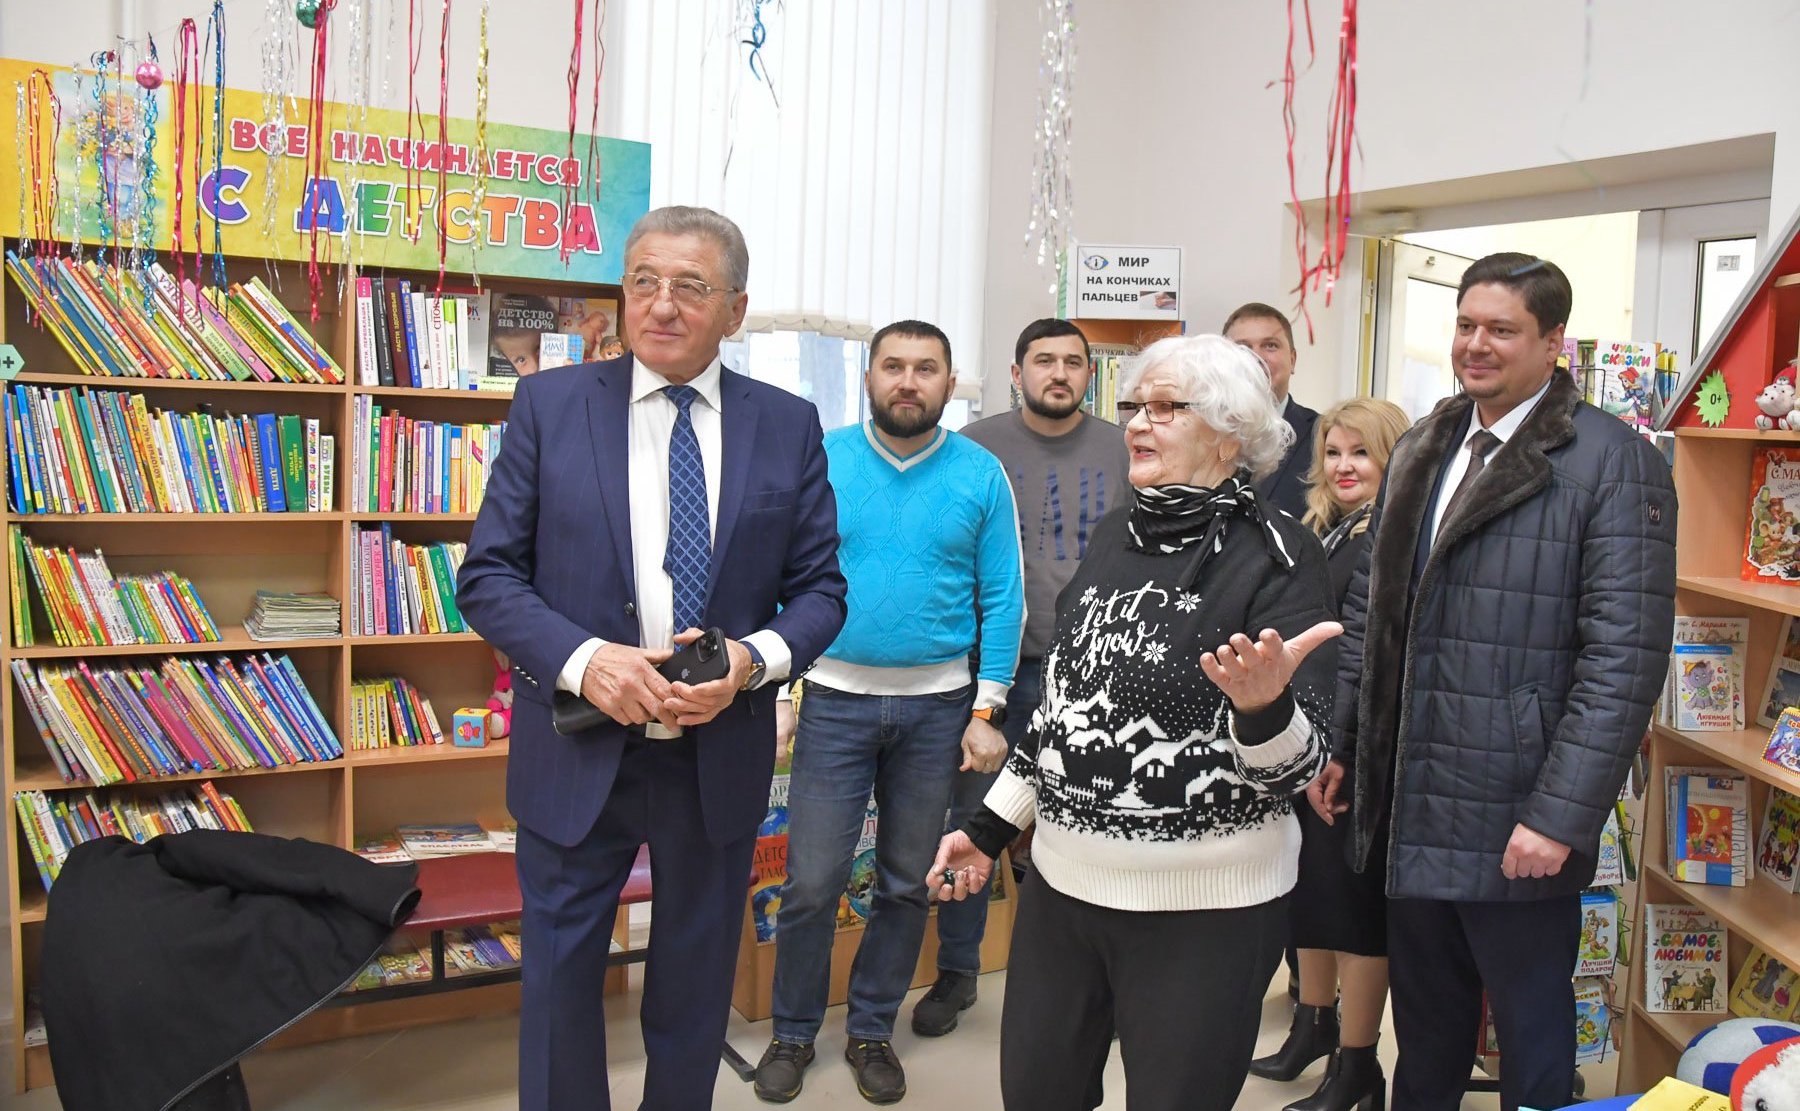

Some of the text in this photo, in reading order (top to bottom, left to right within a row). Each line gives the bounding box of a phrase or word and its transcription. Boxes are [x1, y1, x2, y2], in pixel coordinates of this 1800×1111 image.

[231, 119, 581, 187] ВСЕ НАЧИНАЕТСЯ
[200, 166, 603, 254] С ДЕТСТВА
[1118, 257, 1150, 268] МИР
[1086, 276, 1171, 286] НА КОНЧИКАХ
[1082, 292, 1138, 303] ПАЛЬЦЕВ
[498, 308, 554, 320] ДЕТСТВО
[498, 318, 554, 330] на 100%
[1602, 354, 1650, 368] СКАЗКИ
[1710, 393, 1722, 405] 0+
[1732, 808, 1746, 875] МАРШАК
[1660, 933, 1718, 948] САМОЕ
[1654, 950, 1722, 962] ЛЮБИМОЕ
